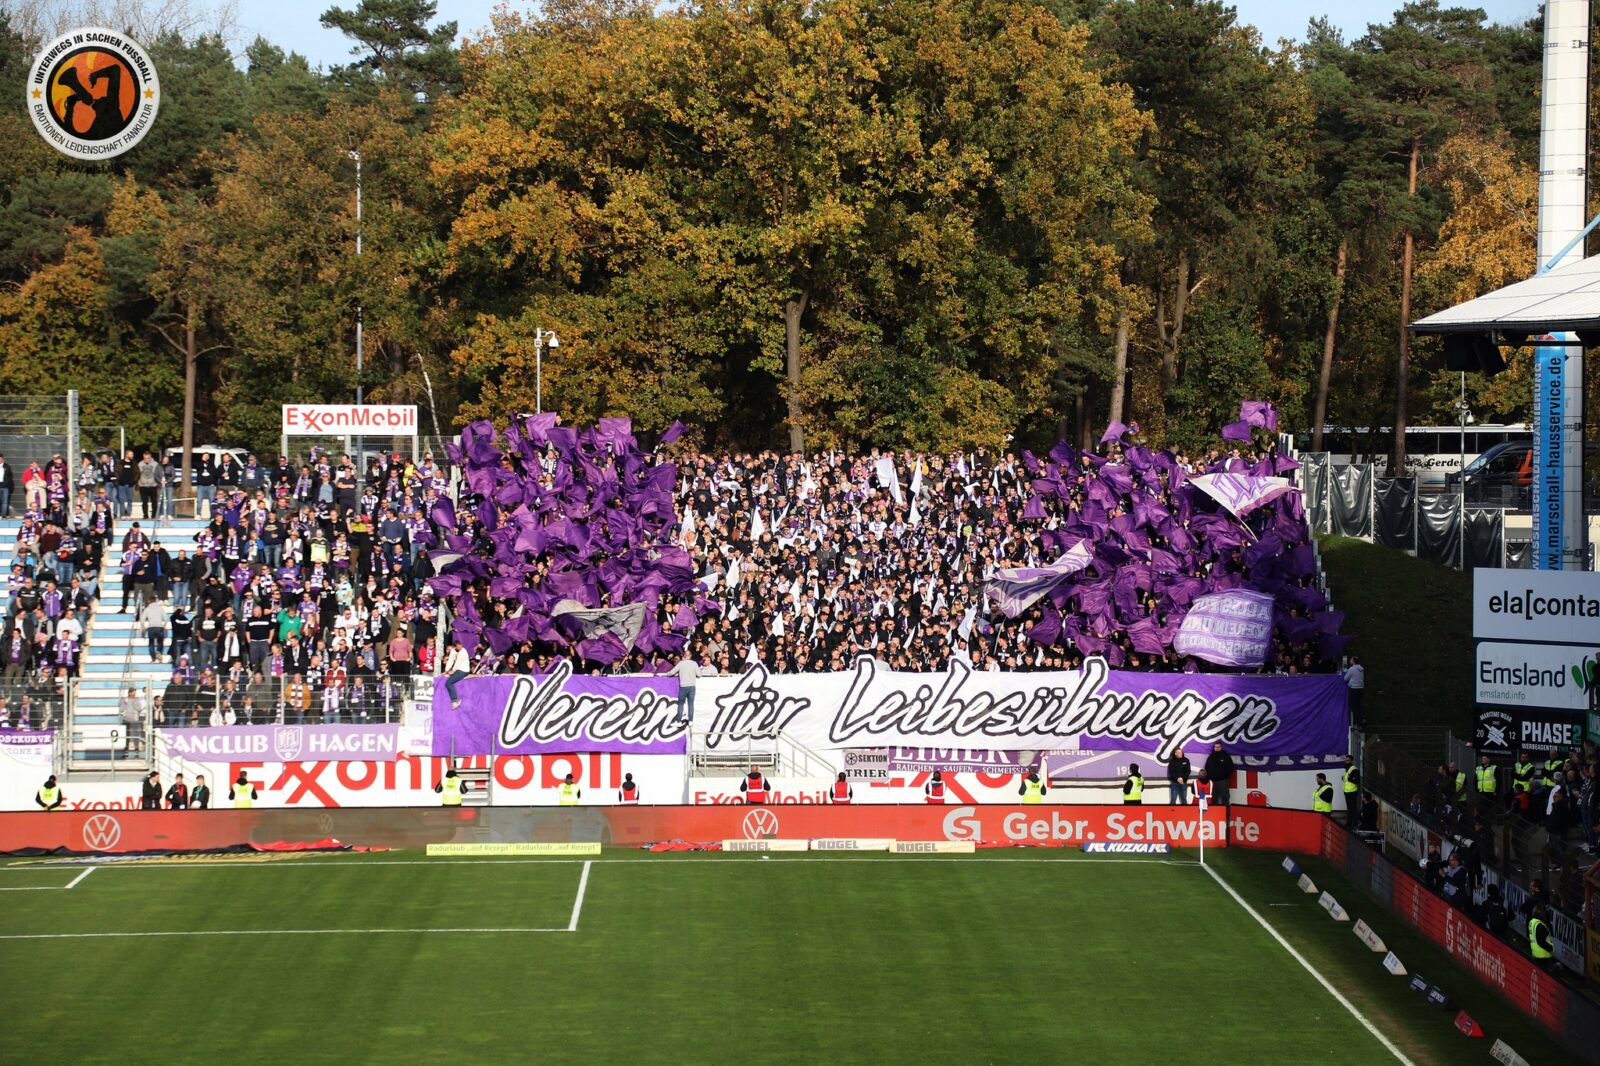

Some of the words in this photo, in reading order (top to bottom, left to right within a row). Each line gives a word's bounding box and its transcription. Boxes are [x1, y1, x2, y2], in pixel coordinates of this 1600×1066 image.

[286, 407, 414, 432] ExxonMobil
[1427, 458, 1463, 467] Gerdes
[1532, 362, 1542, 570] WASSERSCHADENSANIERUNG
[1546, 356, 1562, 570] w.marschall-hausservice.de
[1480, 661, 1566, 688] Emsland
[1479, 689, 1526, 700] emsland.info
[498, 659, 687, 745] Verein
[706, 662, 810, 749] für
[830, 654, 1281, 766] Leibesübungen
[1479, 711, 1500, 720] MARITIME
[1500, 711, 1513, 723] WEAR
[0, 734, 51, 744] OSTKURVE
[110, 729, 119, 743] 9
[1476, 729, 1485, 738] 20
[1509, 731, 1516, 740] 12
[1521, 721, 1582, 745] PHASE2
[163, 733, 268, 754] FANCLUB
[309, 733, 394, 753] HAGEN
[858, 754, 888, 763] SEKTION
[845, 769, 888, 778] TRIER
[896, 763, 935, 772] RAUCHEN
[1003, 812, 1095, 840] Gebr.
[1106, 813, 1260, 842] Schwarte
[730, 840, 771, 852] NÖGEL
[817, 838, 859, 850] NÖGEL
[896, 841, 938, 853] NÖGEL
[1107, 842, 1149, 853] KUZKA
